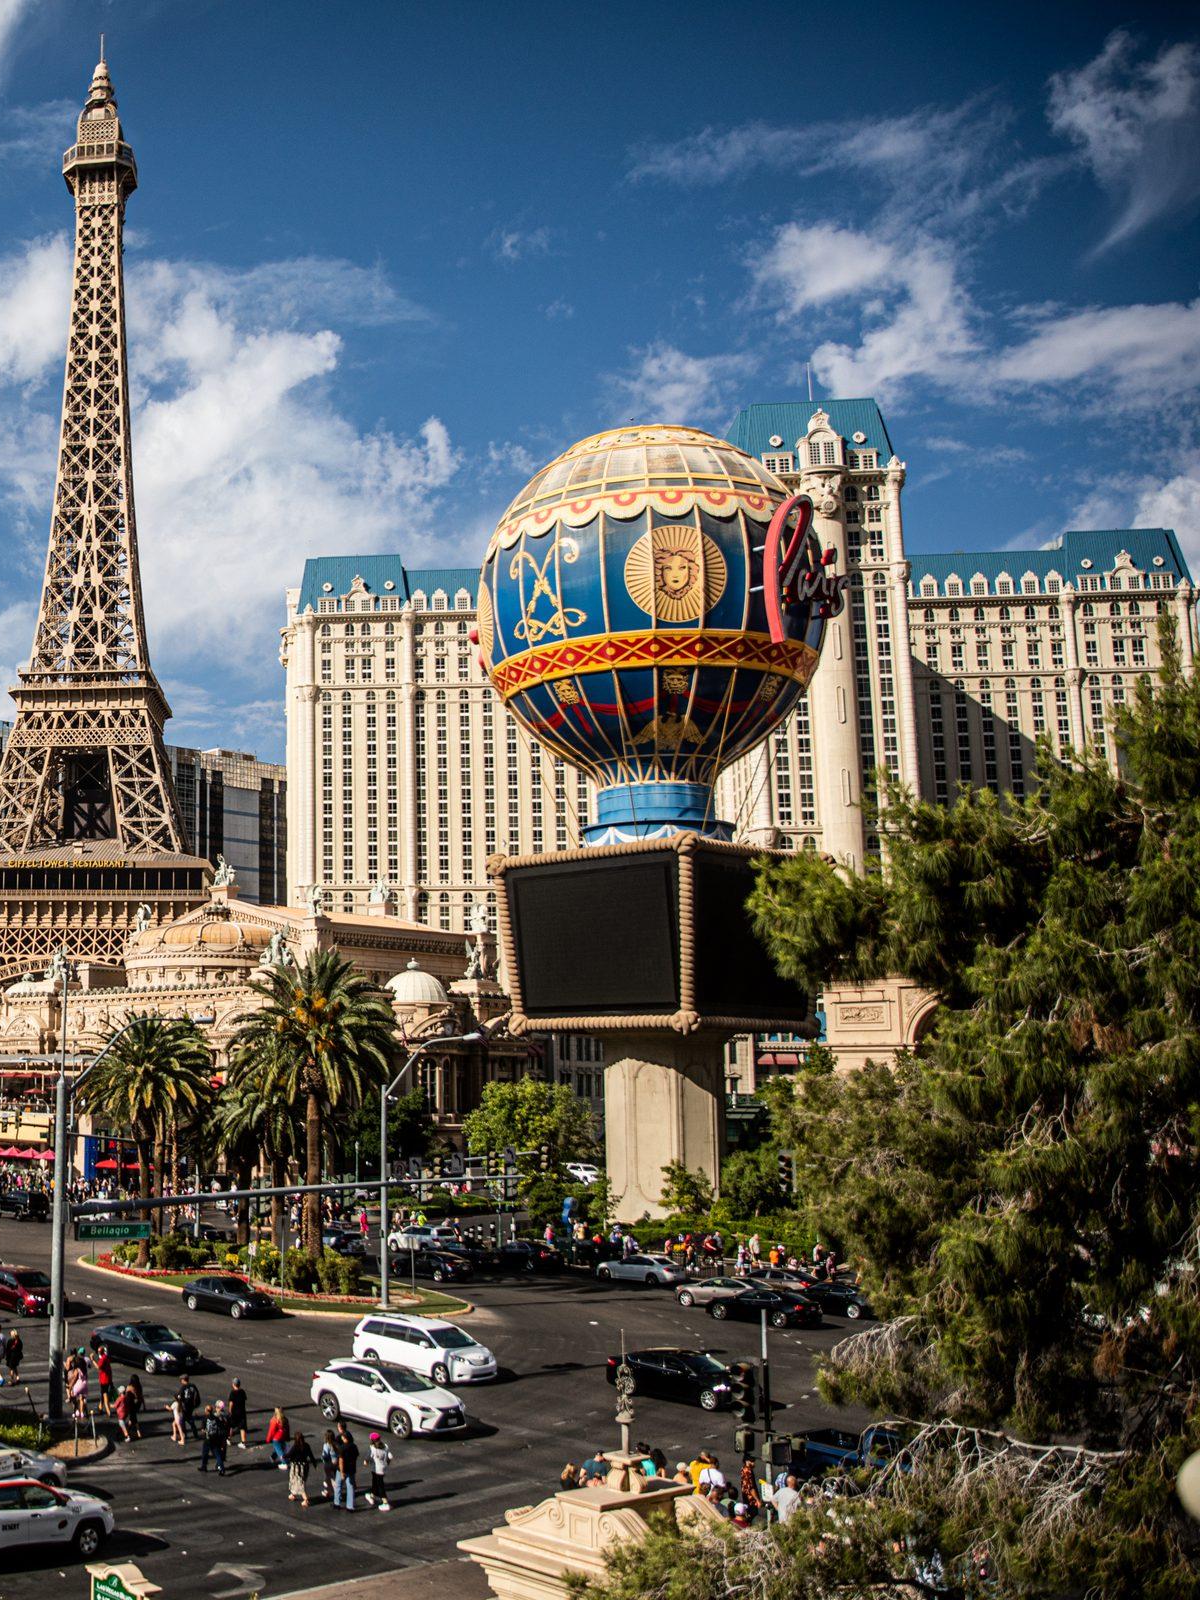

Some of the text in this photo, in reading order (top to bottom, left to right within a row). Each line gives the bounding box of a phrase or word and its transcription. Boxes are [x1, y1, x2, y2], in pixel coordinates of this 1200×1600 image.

[763, 494, 849, 644] Paris
[8, 860, 126, 868] EIFFEL TOWER RESTAURANT
[91, 1226, 129, 1236] Bellagio
